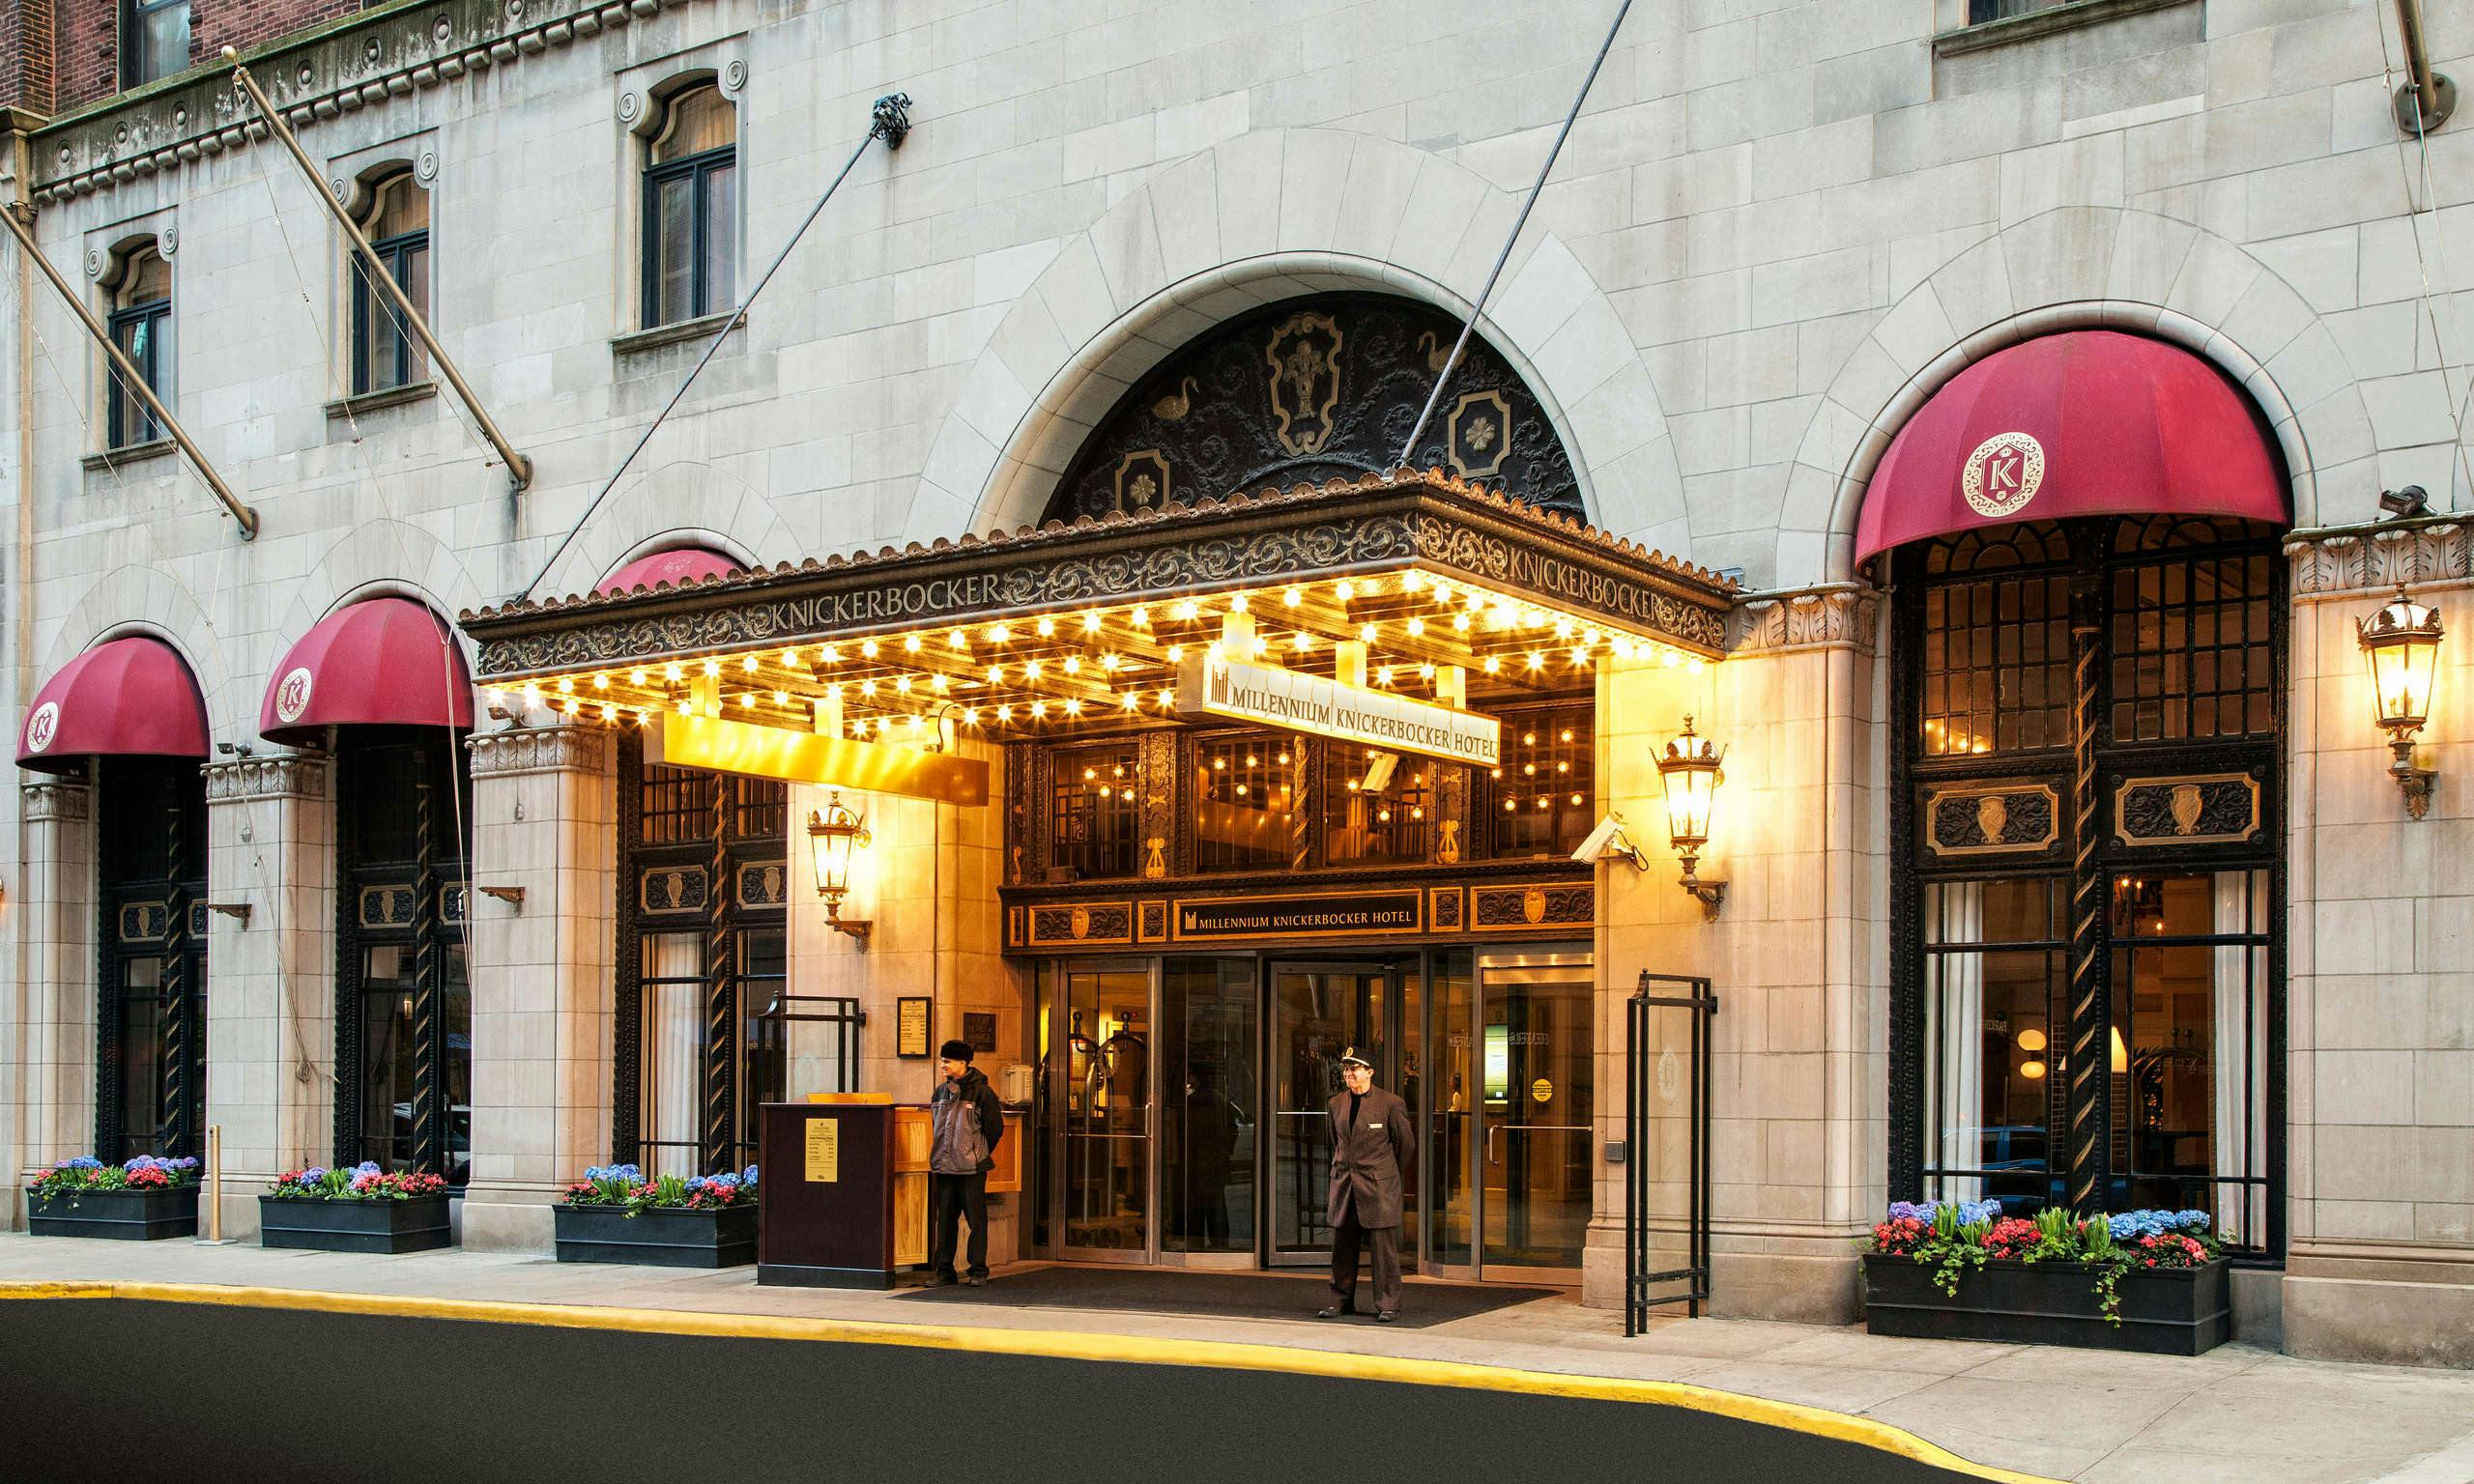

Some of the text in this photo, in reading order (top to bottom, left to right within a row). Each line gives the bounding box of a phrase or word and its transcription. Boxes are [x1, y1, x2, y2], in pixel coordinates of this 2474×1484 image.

[1990, 457, 2019, 490] K
[772, 574, 999, 631] KNICKERBOCKER
[1510, 547, 1658, 620] KNICKERBOCKER
[287, 685, 302, 704] K
[1233, 687, 1496, 758] MILLENNIUM KNICKERBOCKER HOTEL
[1199, 911, 1412, 928] MILLENNIUM KNICKERBOCKER HOTEL
